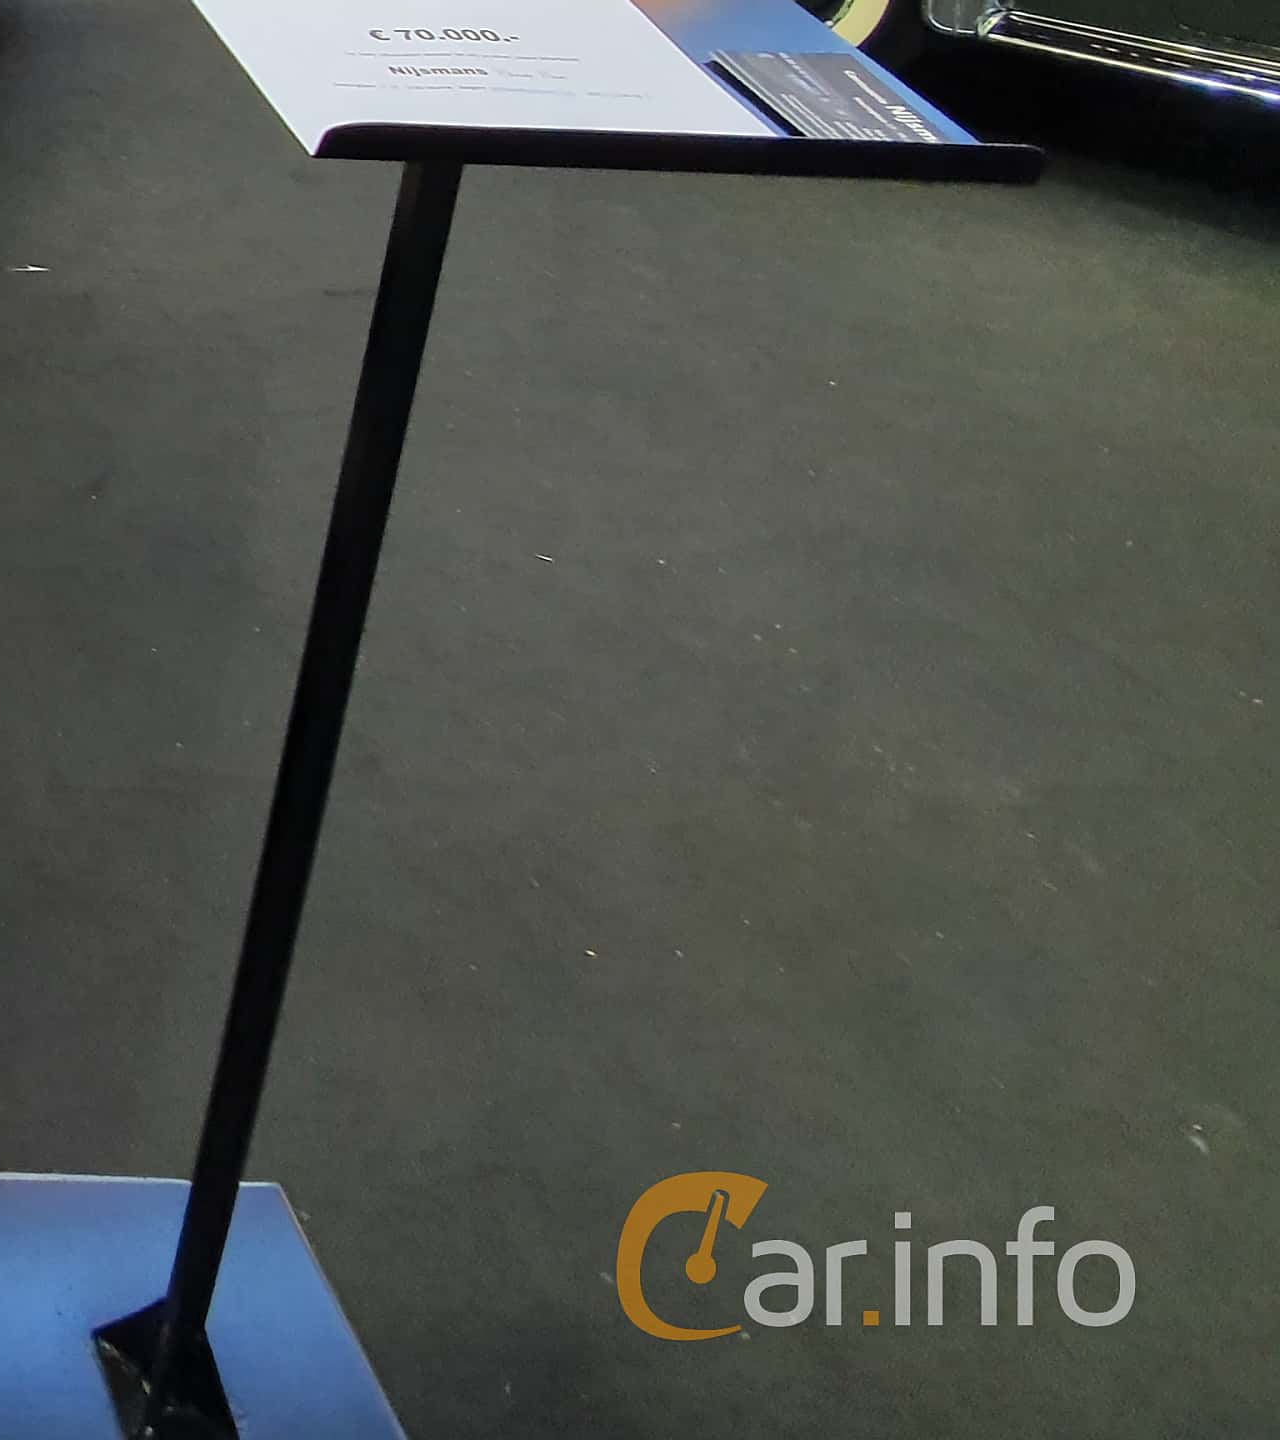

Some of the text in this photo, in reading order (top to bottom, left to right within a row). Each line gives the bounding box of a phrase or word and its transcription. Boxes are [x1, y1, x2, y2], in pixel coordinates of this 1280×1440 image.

[368, 29, 391, 41] €
[388, 65, 490, 78] Nijsmans
[885, 105, 940, 143] Nijsm
